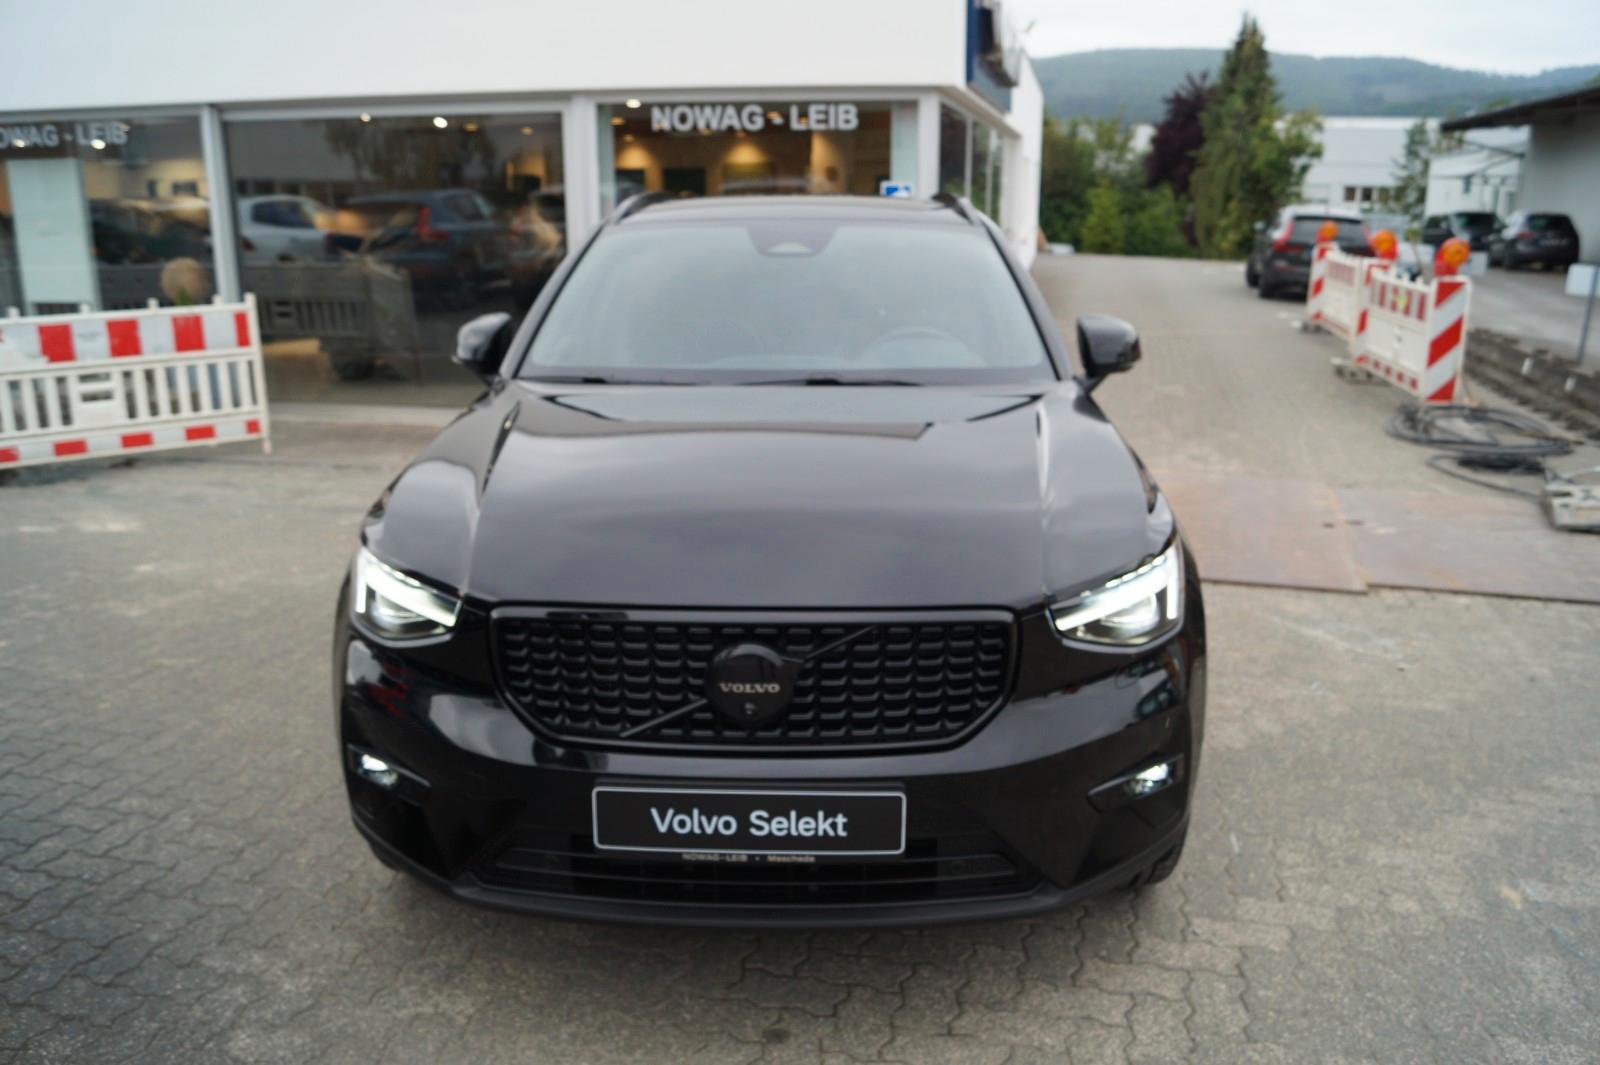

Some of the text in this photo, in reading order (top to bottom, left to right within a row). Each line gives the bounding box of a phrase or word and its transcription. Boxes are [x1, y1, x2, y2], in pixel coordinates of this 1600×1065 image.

[650, 104, 765, 133] NOWAG
[789, 104, 859, 132] LEIB
[719, 682, 781, 694] VOLVO
[650, 807, 848, 837] Volvo Selekt
